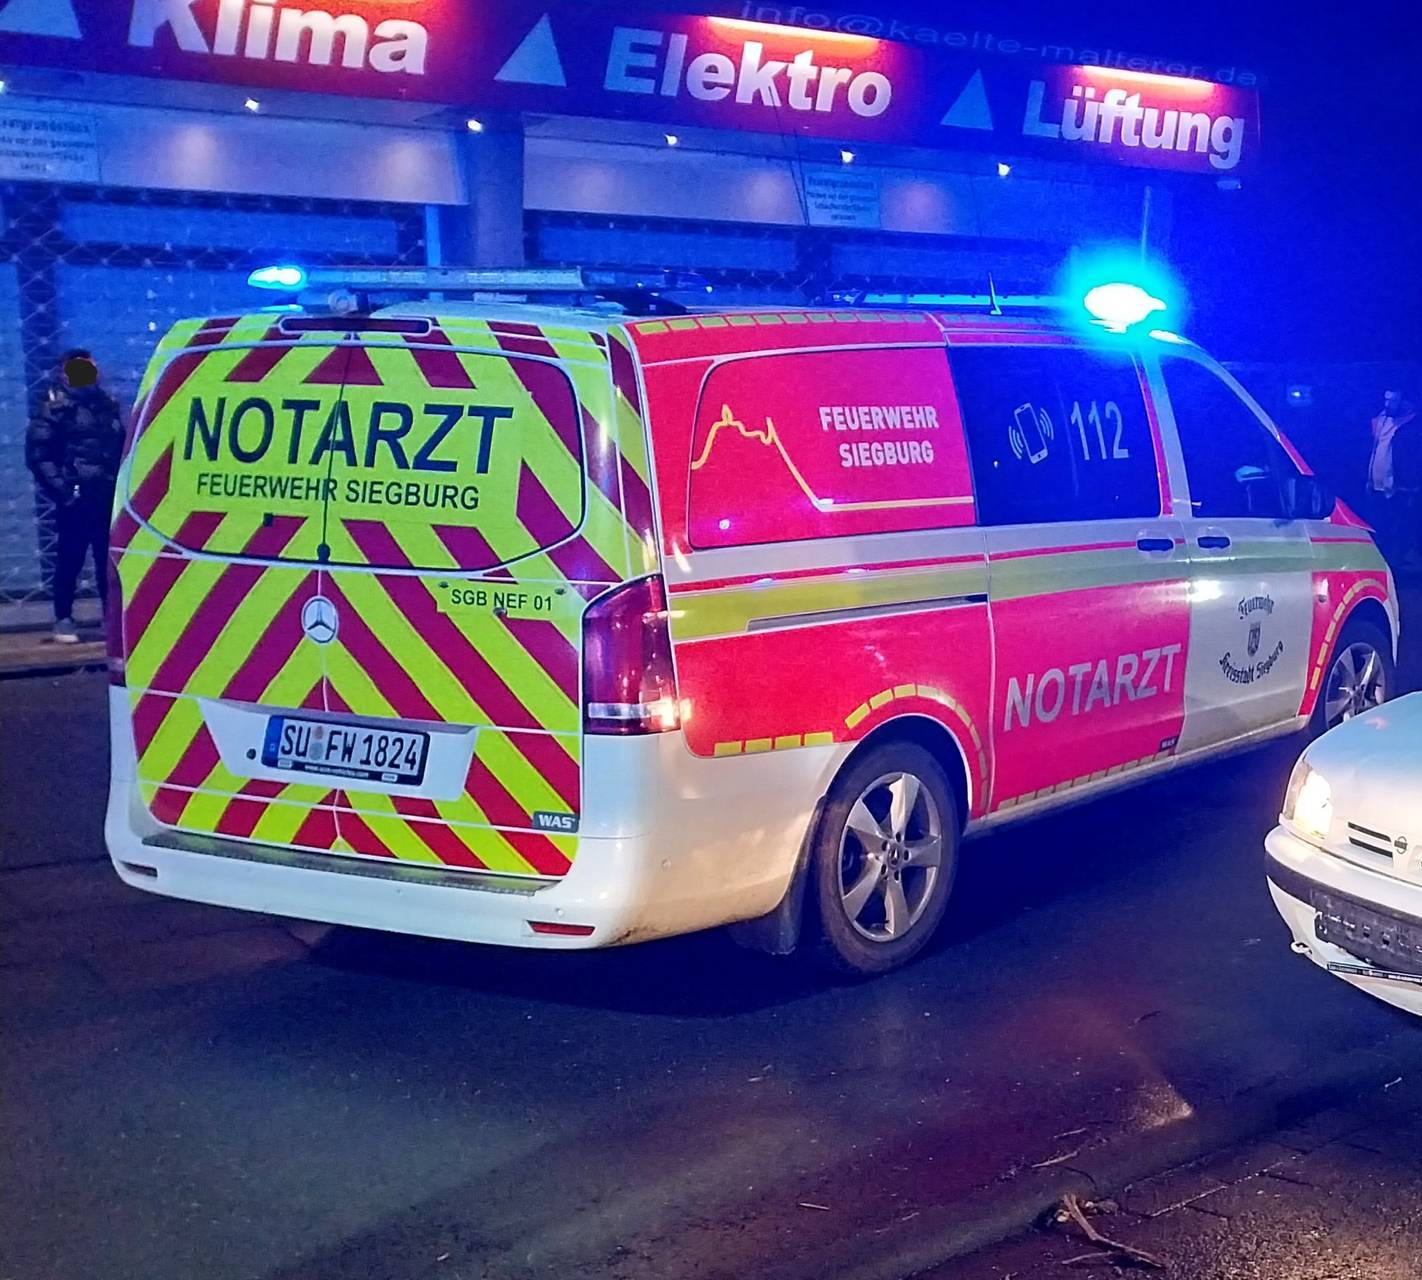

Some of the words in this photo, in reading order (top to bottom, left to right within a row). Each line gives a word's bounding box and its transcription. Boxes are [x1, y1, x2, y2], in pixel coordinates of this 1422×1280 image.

[127, 0, 428, 75] Klima
[603, 26, 892, 117] Elektro
[1022, 80, 1245, 169] Lüftung
[183, 397, 514, 474] NOTARZT
[820, 406, 939, 431] FEUERWEHR
[1071, 401, 1129, 460] 112
[839, 440, 935, 467] SIEGBURG
[197, 473, 338, 501] FEUERWEHR
[345, 480, 479, 510] SIEGBURG
[451, 589, 487, 606] SGB
[494, 592, 528, 609] NEF
[534, 595, 552, 611] 01
[1003, 643, 1182, 732] NOTARZT
[281, 725, 311, 757] SU
[538, 814, 574, 829] WAS
